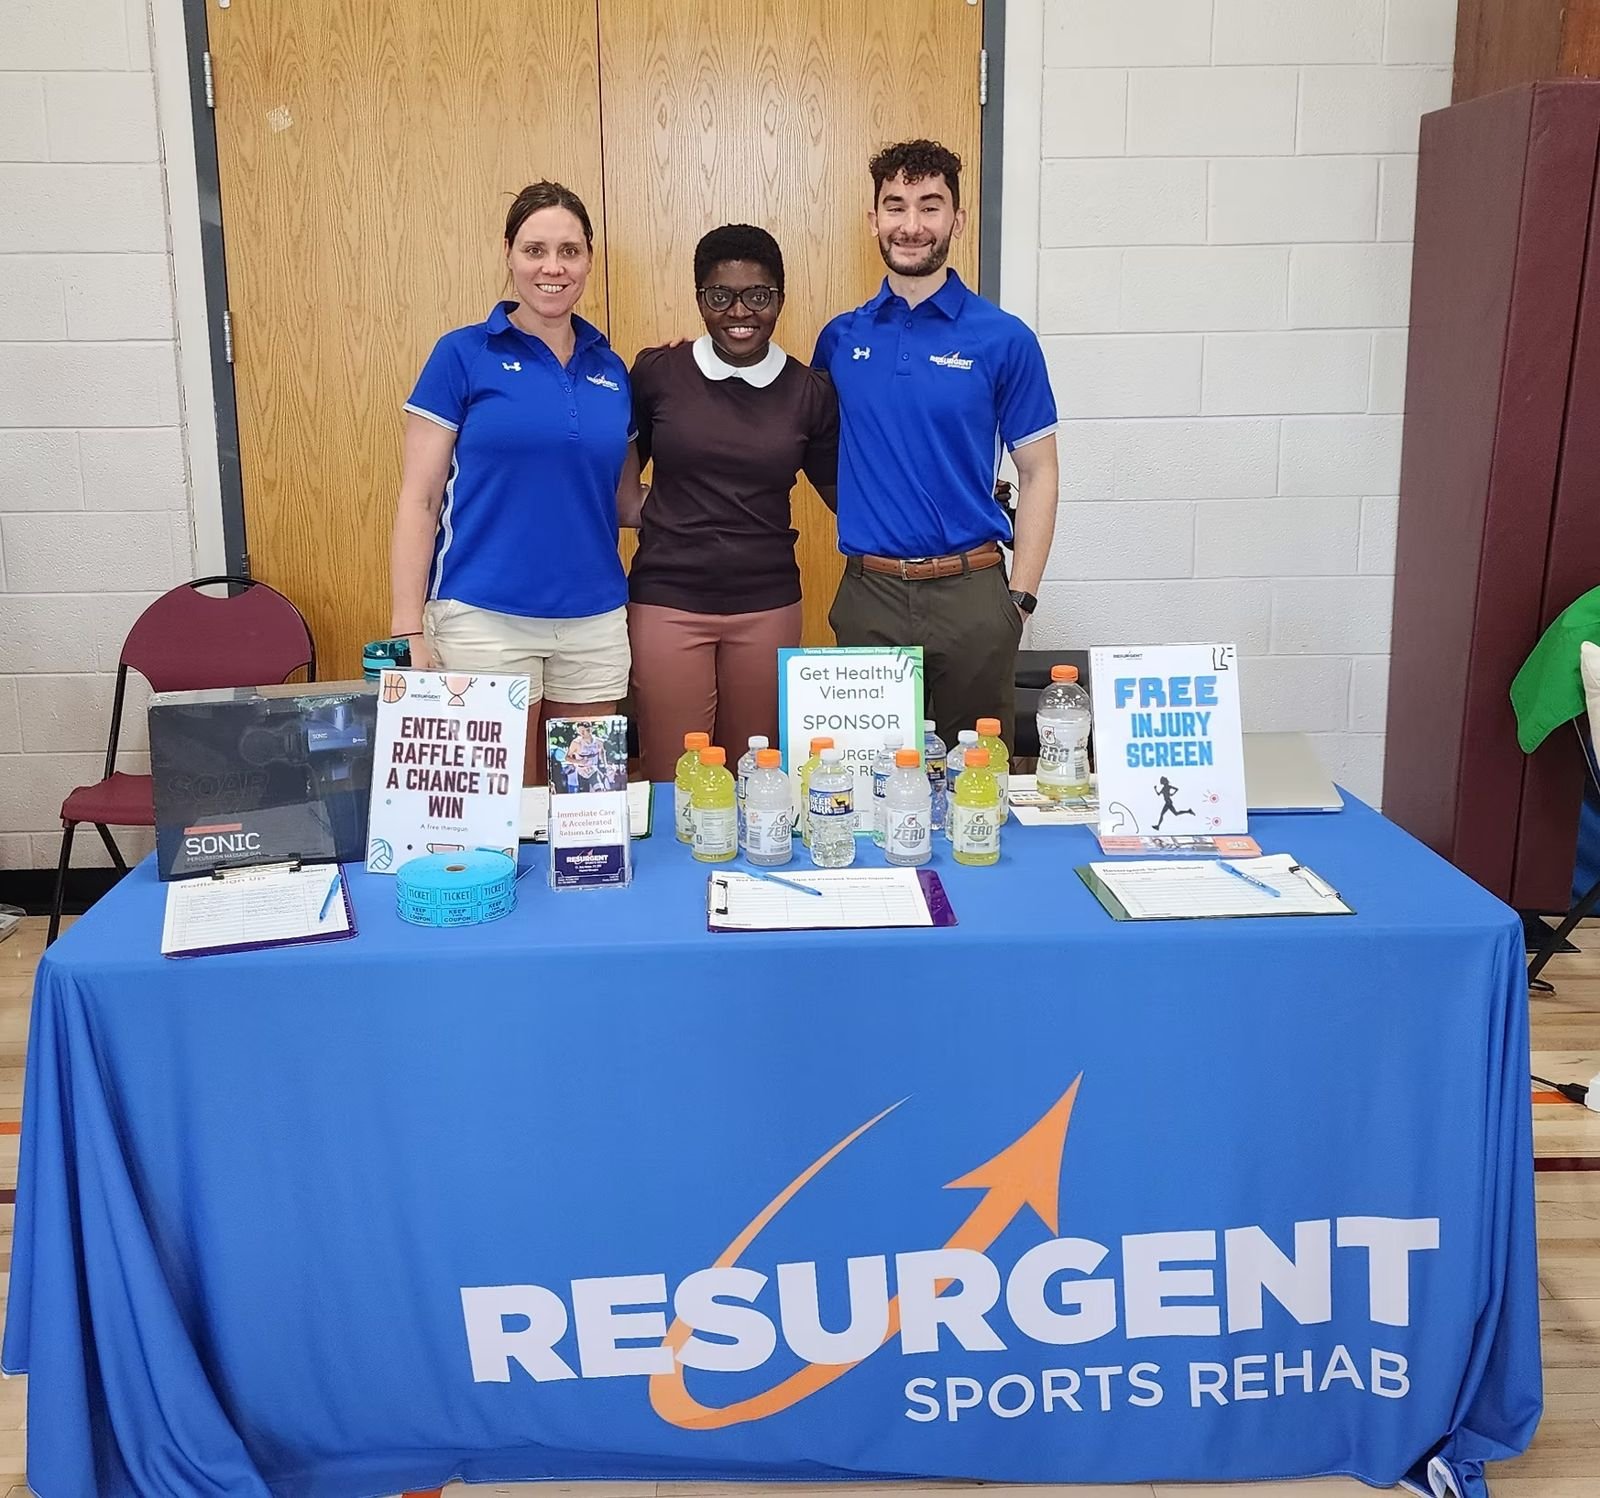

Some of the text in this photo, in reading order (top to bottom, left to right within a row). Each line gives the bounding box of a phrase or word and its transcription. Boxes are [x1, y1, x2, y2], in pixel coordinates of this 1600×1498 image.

[800, 666, 904, 682] Get Healthy
[820, 686, 884, 700] Vienna!
[1114, 676, 1218, 709] FREE
[803, 714, 900, 730] SPONSOR
[1131, 712, 1212, 738] INJURY
[401, 716, 502, 743] ENTER OUR
[392, 742, 508, 770] RAFFLE FOR
[1126, 741, 1214, 768] SCREEN
[386, 768, 510, 795] A CHANCE TO
[428, 795, 464, 819] WIN
[810, 796, 832, 806] DEER
[558, 810, 597, 818] Immediate
[810, 804, 832, 814] PARK
[568, 818, 612, 828] Accelerated
[963, 824, 993, 836] ZERO
[894, 828, 926, 840] ZERO
[186, 832, 260, 856] SONIC
[566, 854, 608, 864] RESURGENT
[408, 888, 430, 900] TICKET
[444, 891, 470, 900] TICKET
[484, 882, 504, 896] TICKET
[488, 900, 502, 909] KEEP
[410, 914, 430, 922] COUPON
[484, 908, 506, 918] COUPON
[459, 1216, 1440, 1384] RESURGENT
[903, 1343, 1412, 1424] SPORTS REHAB
